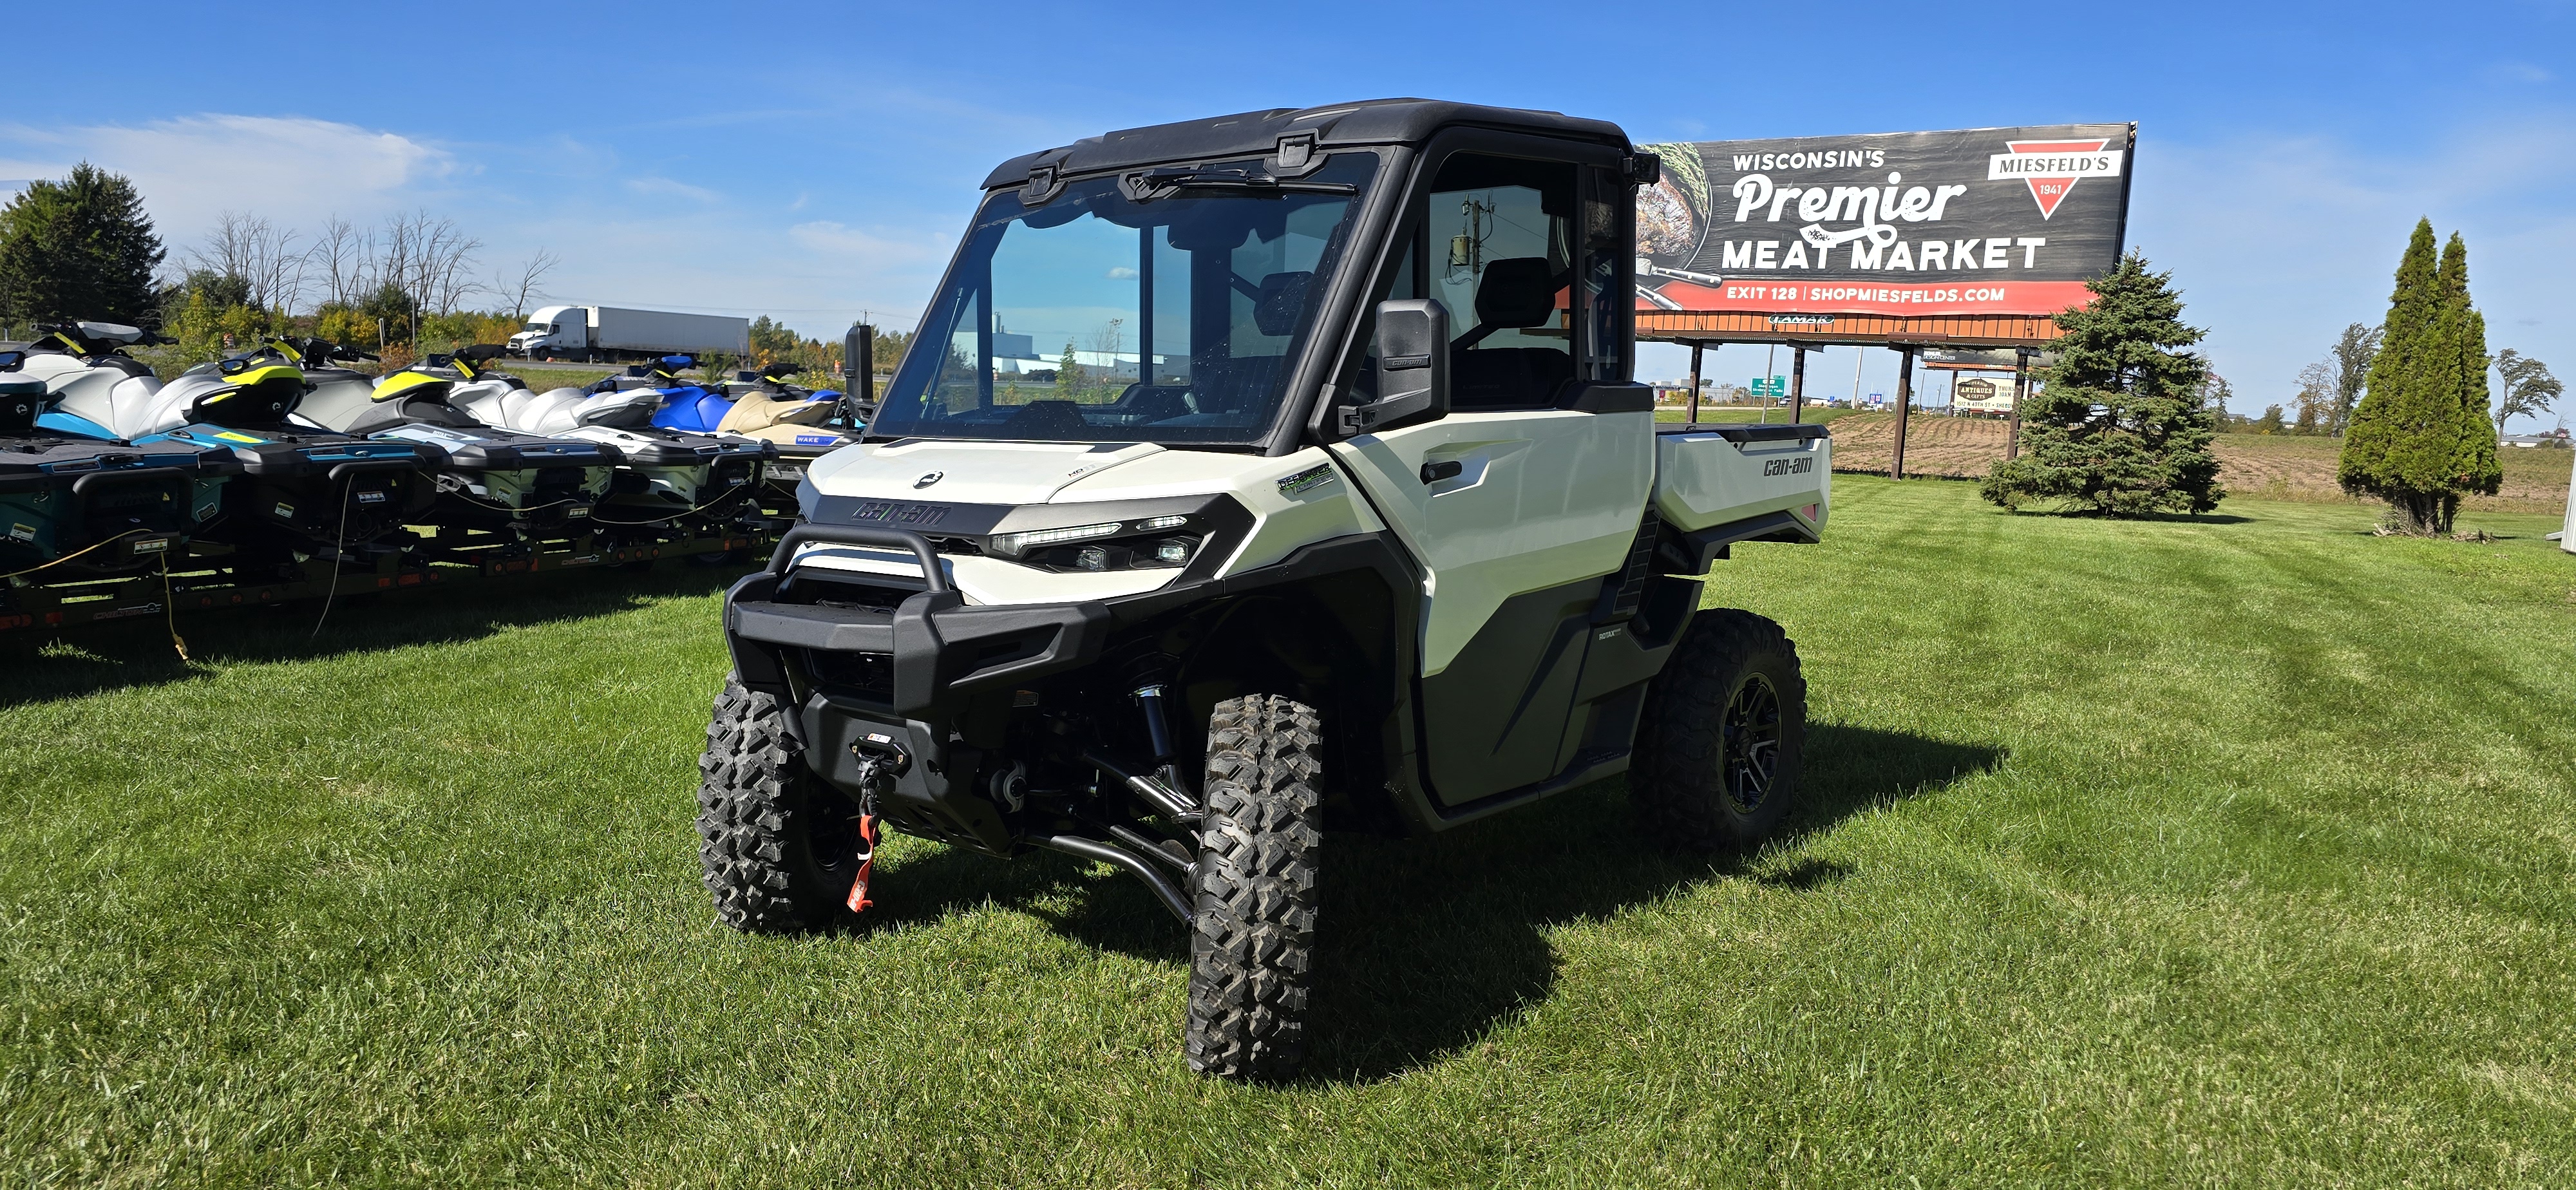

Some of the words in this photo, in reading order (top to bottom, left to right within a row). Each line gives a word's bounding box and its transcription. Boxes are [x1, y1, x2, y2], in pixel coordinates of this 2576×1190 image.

[1733, 150, 1885, 171] WISCONSIN'S
[2000, 157, 2108, 173] MIESFELD'S
[2040, 184, 2061, 195] 1941
[1732, 171, 1967, 247] Premier
[1721, 240, 1836, 269] MEAT
[1850, 238, 2047, 271] MARKET
[1727, 287, 1766, 299] EXIT
[1771, 287, 1797, 300] 128
[1810, 287, 2005, 304] SHOPMIESFELDS.COM
[1763, 457, 1813, 477] can-am
[1278, 466, 1329, 489] DEFENDER
[851, 502, 952, 525] can-am
[1599, 630, 1615, 640] ROTAX
